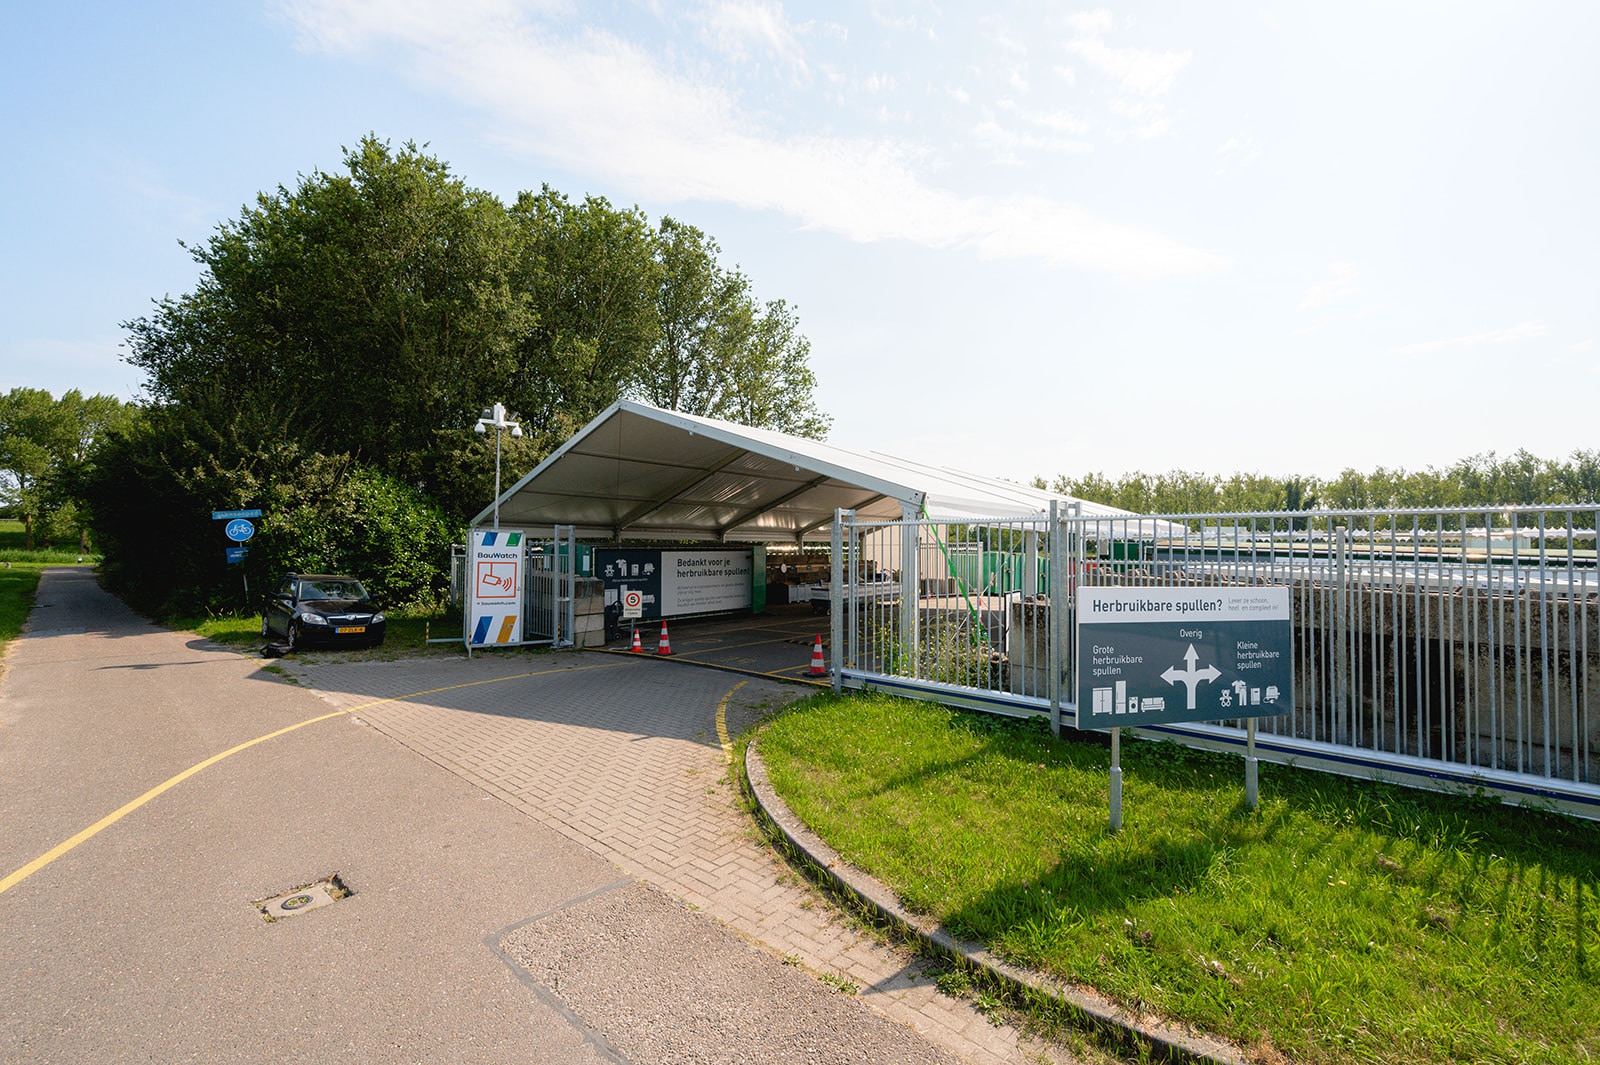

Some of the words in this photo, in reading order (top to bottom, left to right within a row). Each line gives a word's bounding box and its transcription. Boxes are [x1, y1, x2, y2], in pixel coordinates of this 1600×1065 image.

[677, 558, 707, 567] Bedankt
[708, 559, 723, 567] voor
[724, 558, 731, 567] je
[677, 568, 723, 578] herbruikbare
[724, 567, 750, 577] spullen!
[630, 596, 636, 604] 5
[1093, 599, 1173, 612] Herbruikbare
[1175, 599, 1223, 614] spullen?
[1249, 604, 1271, 612] compleet
[1180, 629, 1203, 639] Overig
[1092, 645, 1114, 654] Grote
[1237, 641, 1258, 650] Kleine
[1092, 655, 1143, 665] herbruikbare
[1237, 651, 1280, 660] herbruikbare
[1237, 661, 1262, 671] spullen
[1092, 666, 1122, 677] spullen
